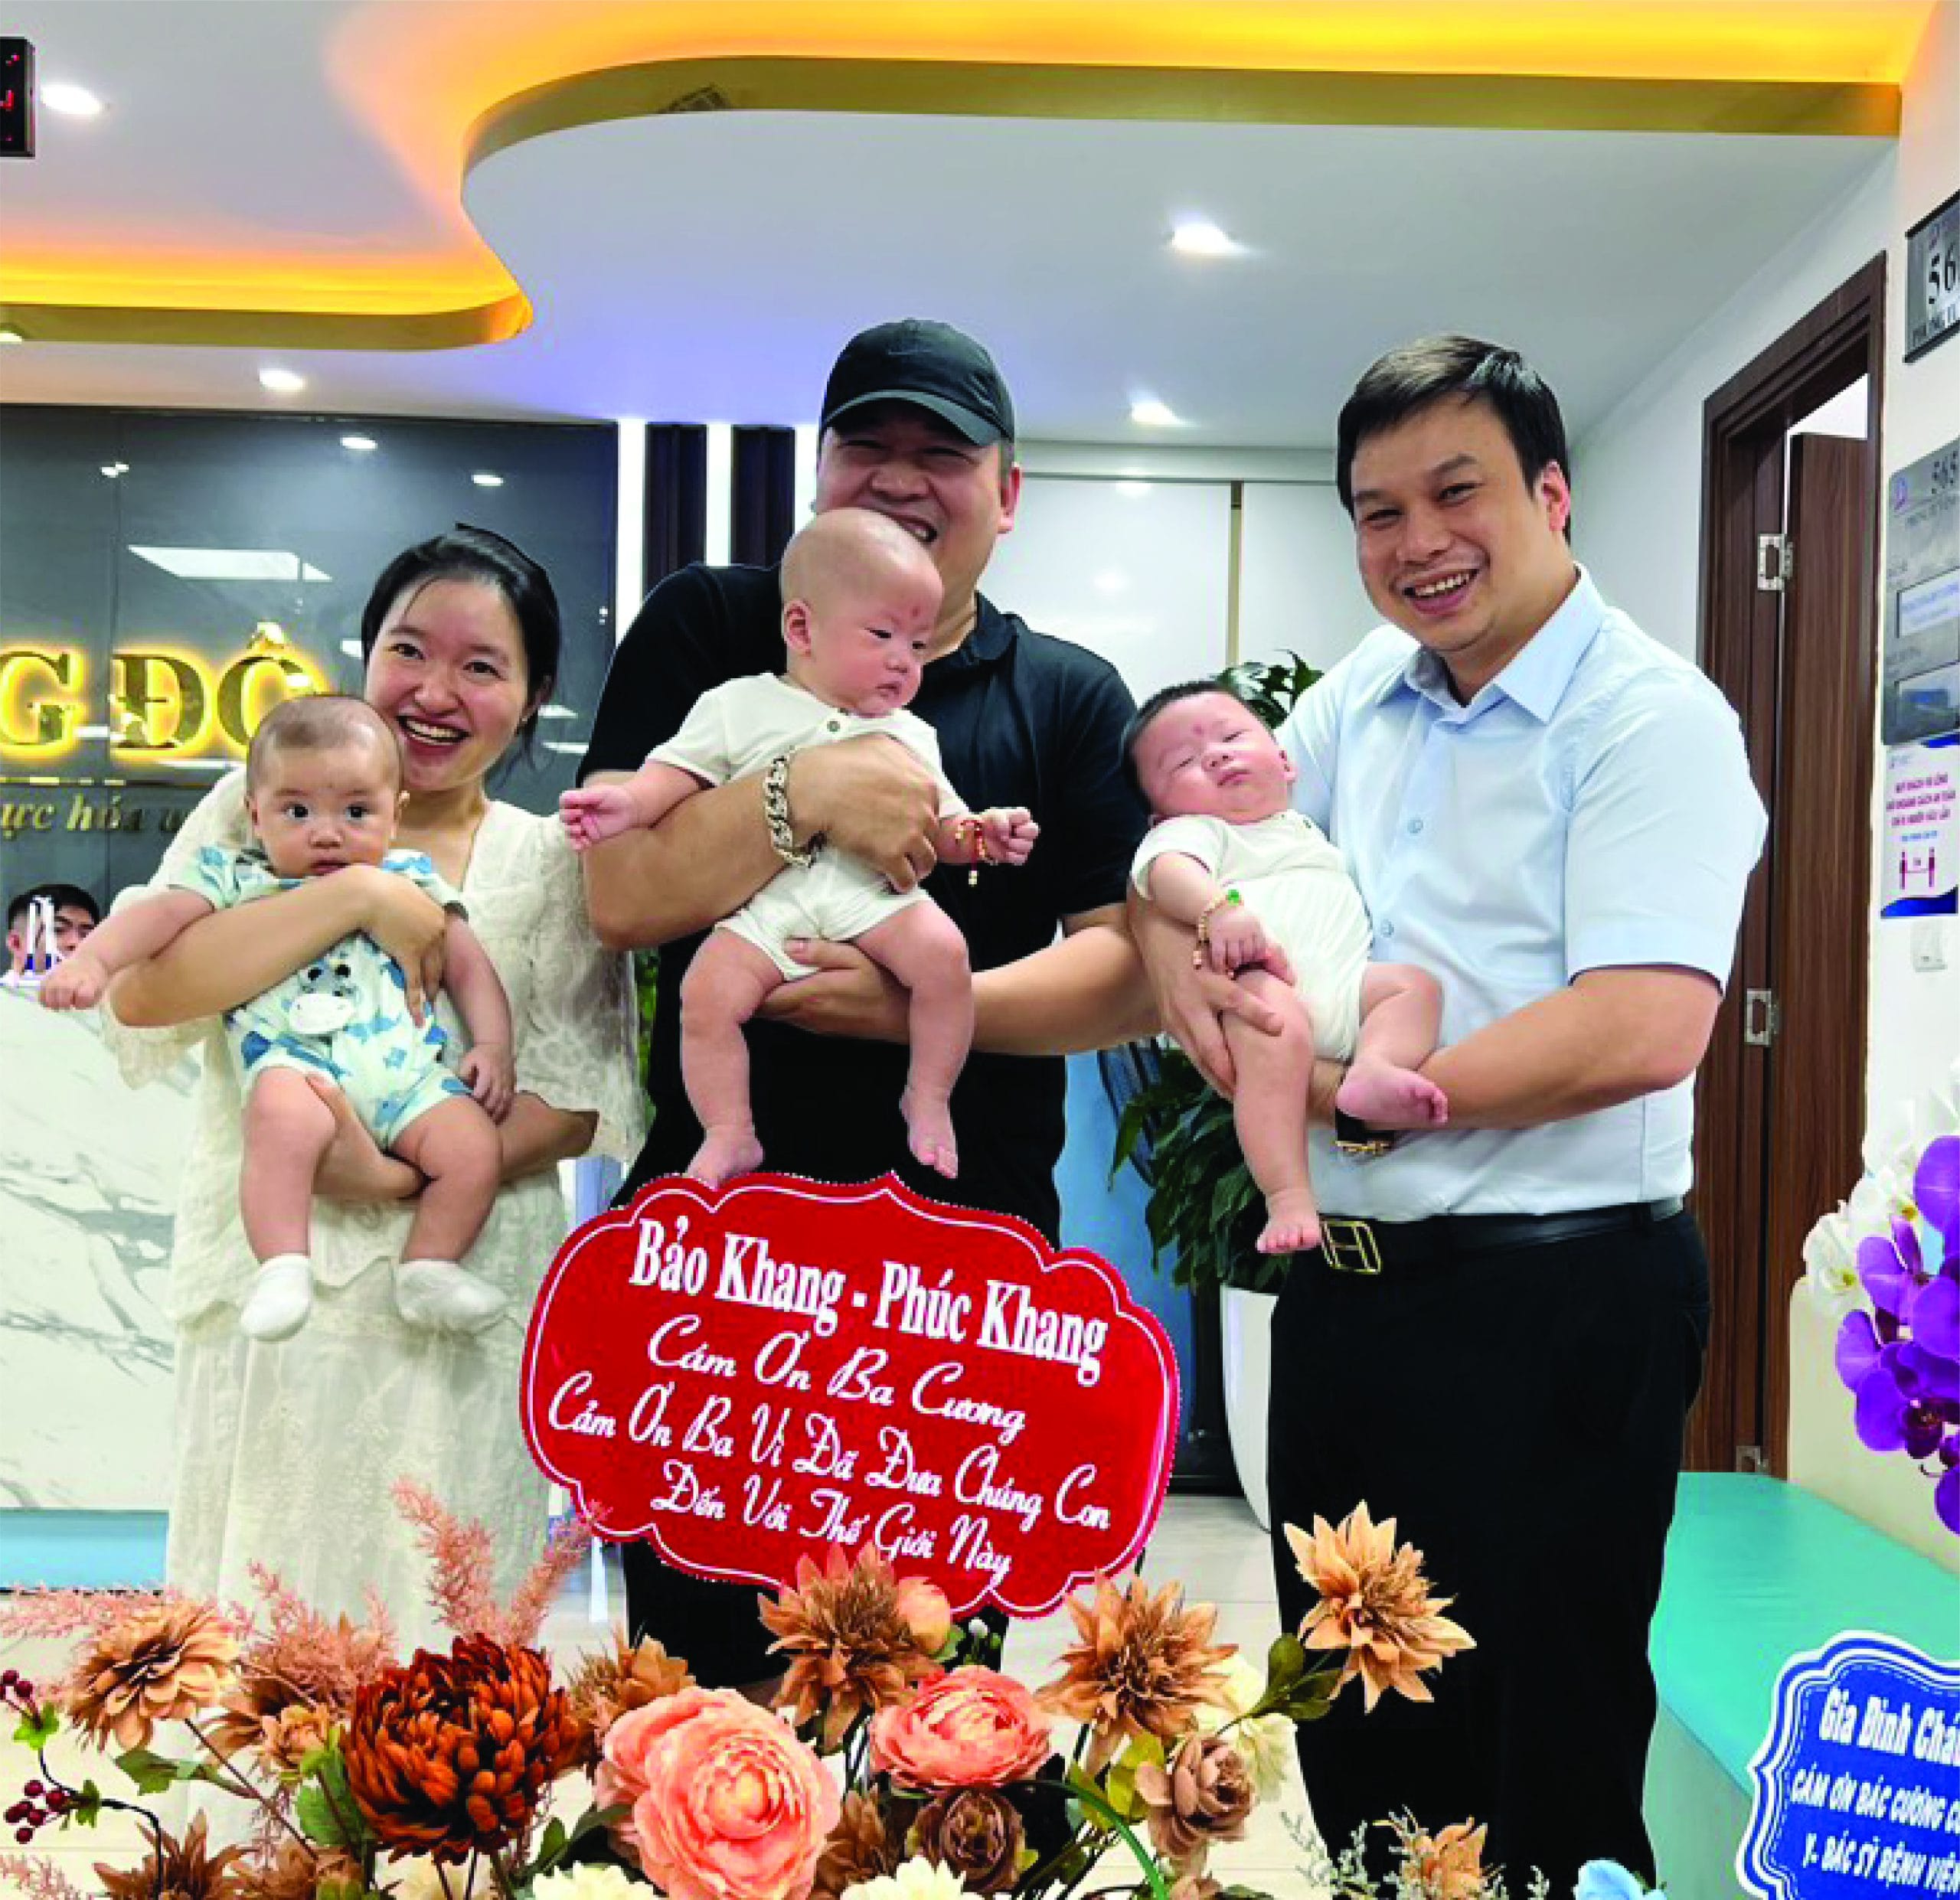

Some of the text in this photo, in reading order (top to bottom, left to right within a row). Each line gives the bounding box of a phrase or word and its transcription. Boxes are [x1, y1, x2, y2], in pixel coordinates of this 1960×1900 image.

[1927, 242, 1960, 305] 56
[629, 1216, 707, 1296] Bảo
[714, 1232, 845, 1335] Khang
[873, 1262, 972, 1341] Phúc
[977, 1280, 1108, 1386] Khang
[755, 1330, 811, 1389] Ơn
[827, 1347, 893, 1405] Ba
[629, 1382, 675, 1446] Ơn
[682, 1396, 733, 1457] Ba
[793, 1414, 856, 1480] Đã
[864, 1427, 942, 1497] Đưa
[956, 1438, 1041, 1531] Chúng
[1057, 1464, 1110, 1529] Con
